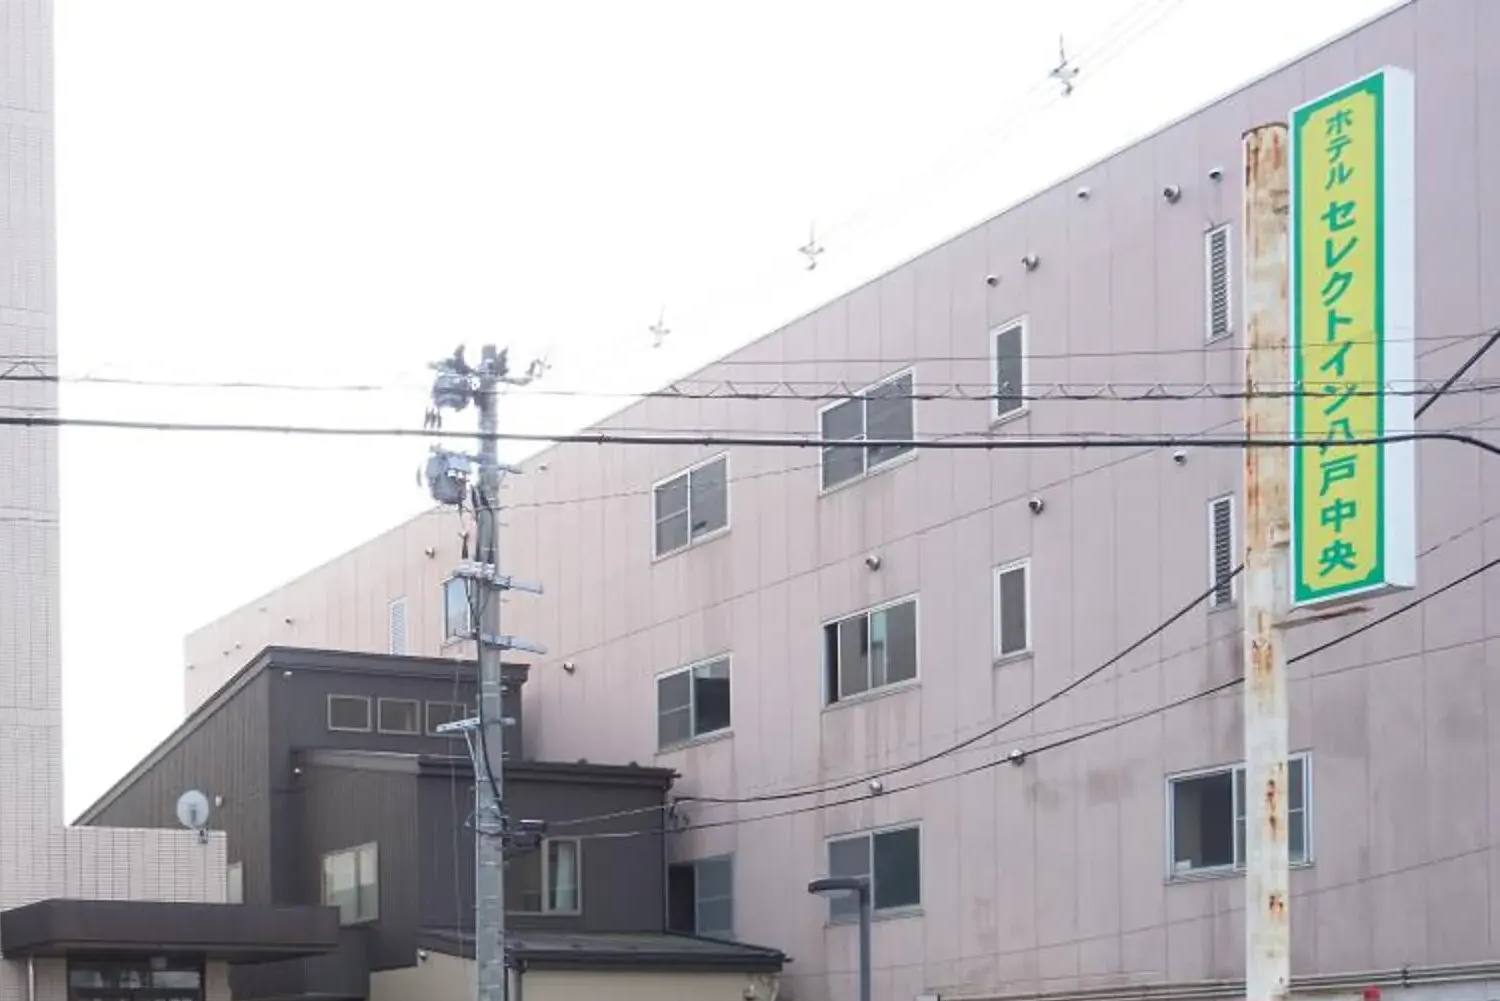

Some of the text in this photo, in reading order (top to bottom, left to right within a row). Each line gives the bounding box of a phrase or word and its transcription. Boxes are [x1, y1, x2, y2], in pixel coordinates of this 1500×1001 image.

[1319, 109, 1359, 574] ホテル セレクトイン八戸中央
